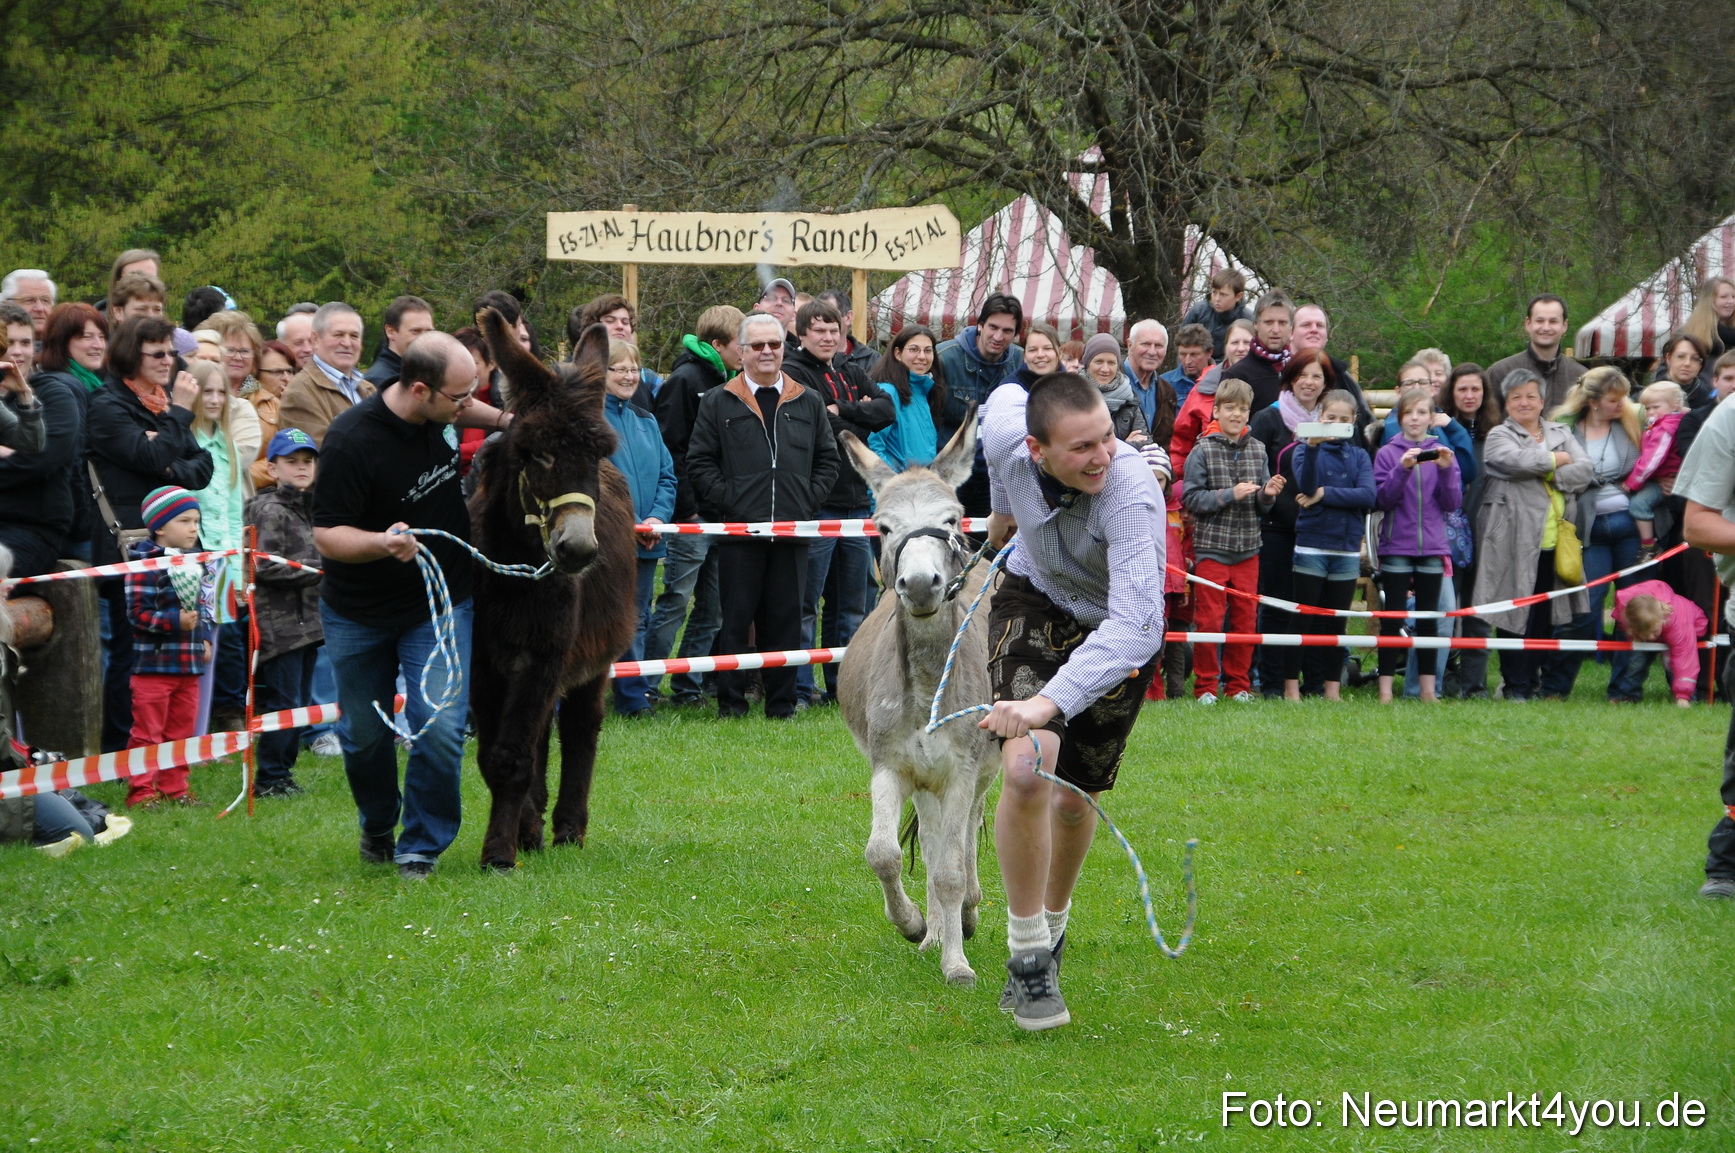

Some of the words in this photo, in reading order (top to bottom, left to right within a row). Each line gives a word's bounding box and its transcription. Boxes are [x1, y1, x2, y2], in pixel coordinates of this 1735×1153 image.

[627, 218, 773, 252] Haubner's
[789, 218, 878, 260] Ranch
[885, 216, 947, 262] ES-ZI-AL
